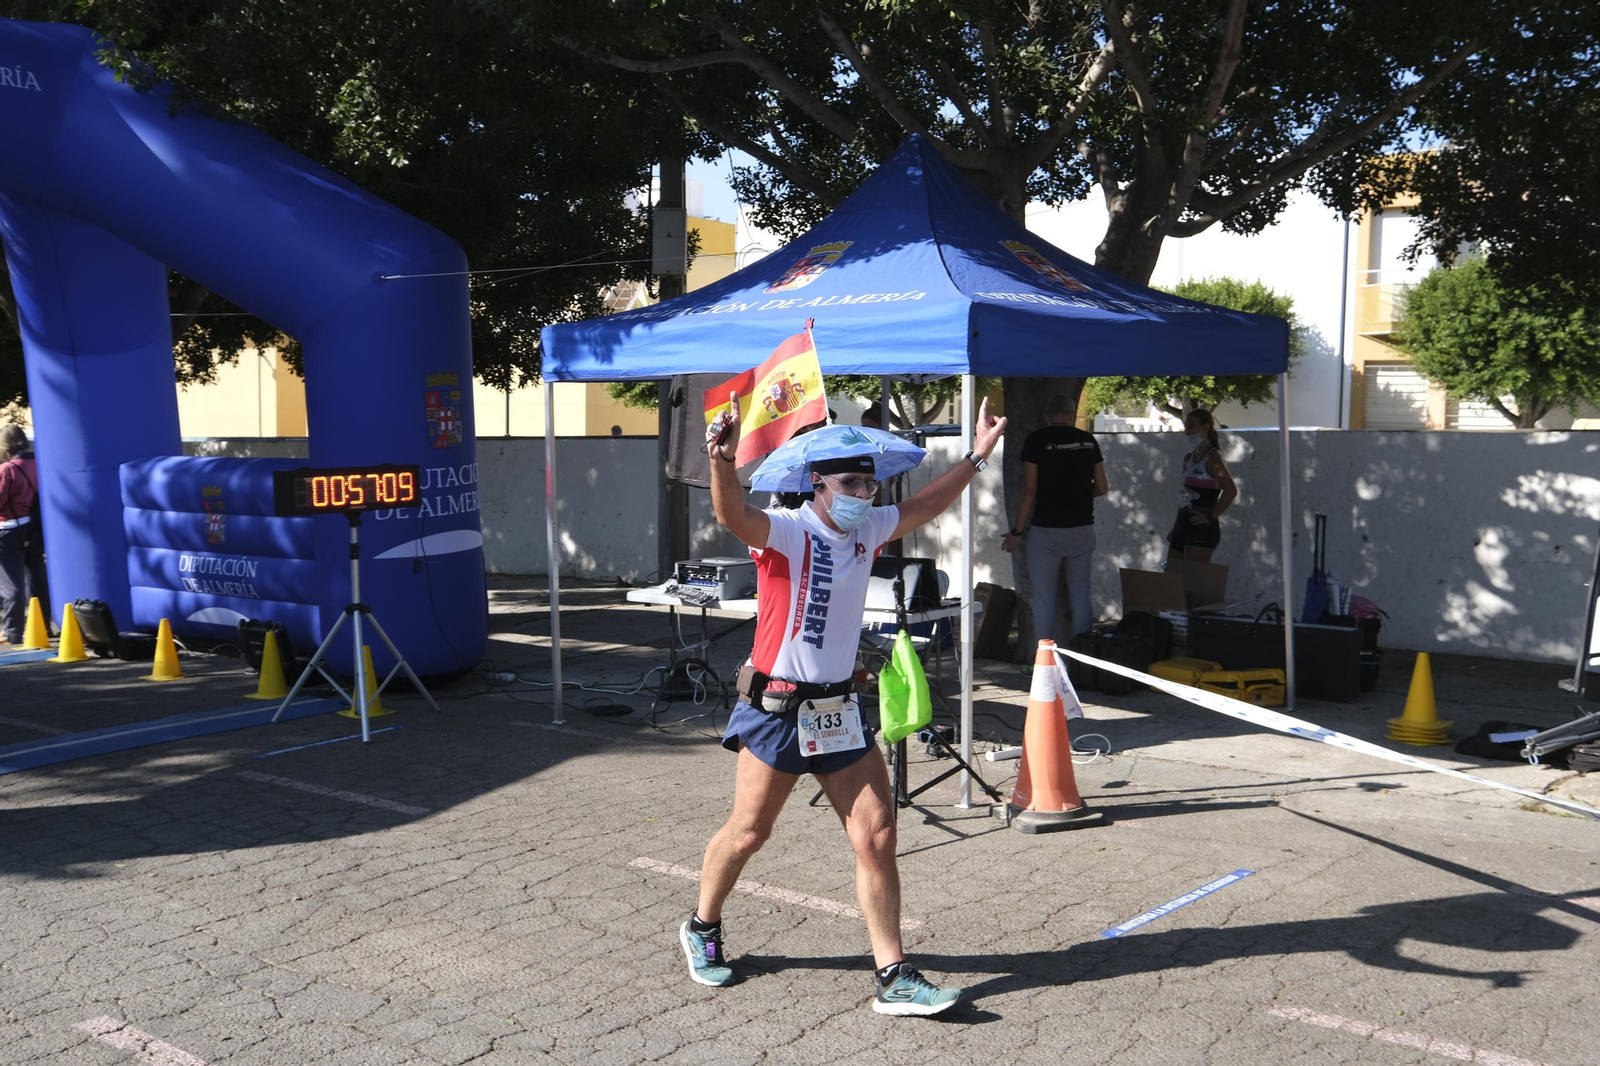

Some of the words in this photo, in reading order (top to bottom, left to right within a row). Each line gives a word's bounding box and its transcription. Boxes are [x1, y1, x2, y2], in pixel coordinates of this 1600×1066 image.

[0, 65, 42, 91] RÍA
[758, 299, 802, 310] DE
[798, 290, 927, 308] ALMERÍA
[312, 472, 415, 507] 00:57:09
[178, 554, 259, 578] DIPUTACIÓN
[181, 577, 202, 593] DE
[202, 578, 260, 599] ALMERÍA
[794, 570, 808, 628] ASCENSORES
[802, 533, 834, 650] PHILBERT
[814, 712, 842, 730] 133
[814, 731, 820, 739] EL
[821, 728, 849, 739] SOMBRILLA
